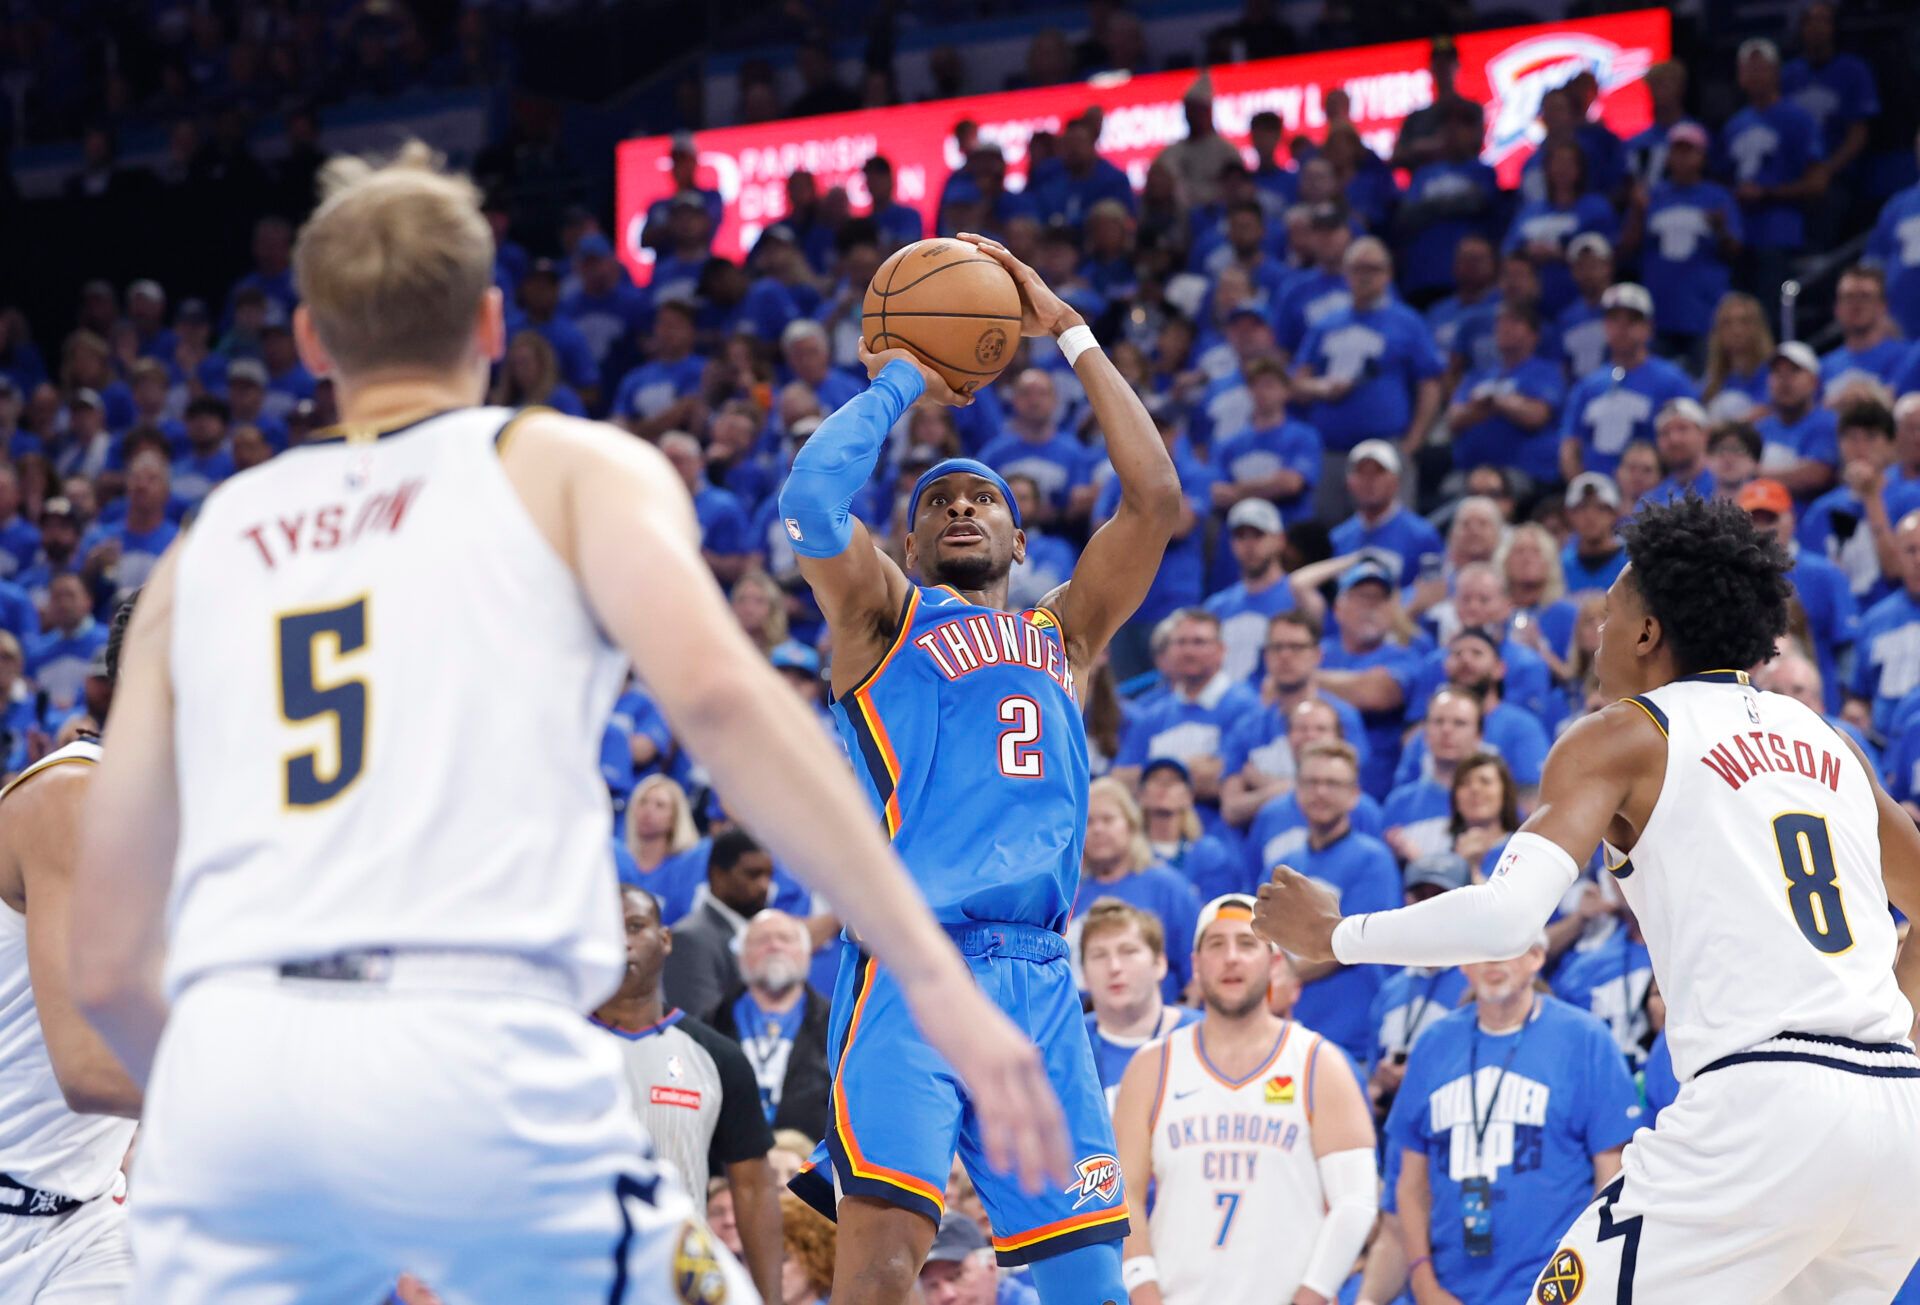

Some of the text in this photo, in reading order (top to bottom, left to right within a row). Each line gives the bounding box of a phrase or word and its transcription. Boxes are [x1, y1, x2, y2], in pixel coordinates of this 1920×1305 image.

[914, 612, 1074, 702] THUNDER
[274, 590, 370, 811] 5
[998, 694, 1044, 778] 2
[1701, 732, 1841, 792] WATSON
[1770, 810, 1856, 957] 8
[1166, 1113, 1299, 1152] OKLAHOMA
[1083, 1164, 1114, 1195] OKC
[1203, 1150, 1258, 1182] CITY
[1214, 1192, 1241, 1248] 7
